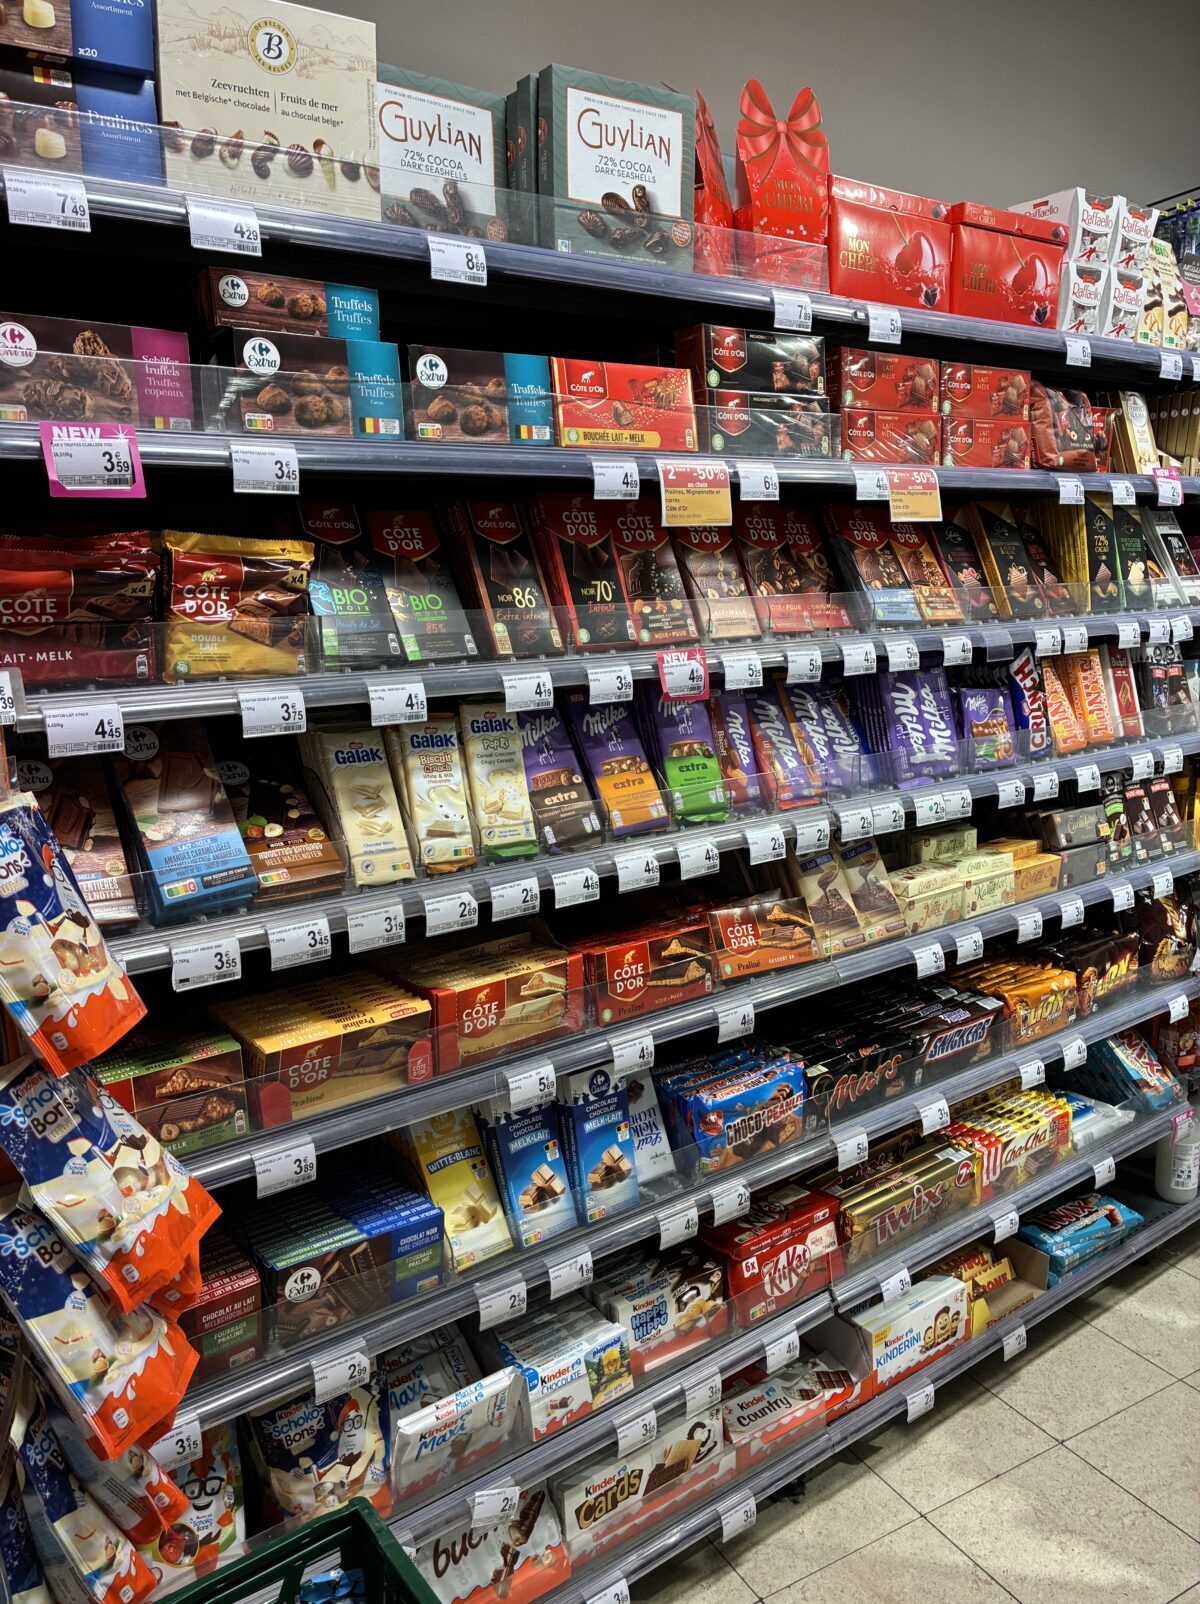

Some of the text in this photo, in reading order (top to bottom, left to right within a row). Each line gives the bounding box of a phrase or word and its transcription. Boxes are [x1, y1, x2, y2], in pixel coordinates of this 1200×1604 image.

[90, 1, 133, 16] Assortiment
[78, 46, 98, 58] x20
[262, 33, 284, 60] B
[210, 78, 270, 99] Zeevruchten
[175, 89, 192, 99] met
[233, 100, 271, 113] chocolade
[280, 91, 339, 112] Fruits de mer
[281, 109, 290, 117] au
[291, 110, 320, 123] chocolat
[100, 130, 142, 144] Assortiment
[403, 149, 464, 171] 72% COCOA
[598, 155, 653, 174] 72% COCOA
[424, 166, 468, 181] SEASHELLS
[614, 170, 656, 184] SEASHELLS
[775, 179, 800, 191] MON
[1081, 208, 1113, 230] Raffaello
[1121, 215, 1152, 239] Raffaello
[848, 237, 870, 253] MON
[222, 287, 248, 301] Extra
[1072, 282, 1101, 301] Raffaello
[1113, 287, 1143, 308] Raffaello
[332, 297, 373, 312] Truffels
[334, 310, 372, 325] Truffes
[247, 354, 279, 369] Extra
[146, 377, 180, 388] Truffes
[355, 372, 396, 387] Truffels
[419, 370, 446, 383] Extra
[144, 387, 184, 399] copeaux
[358, 385, 395, 399] Truffes
[512, 383, 546, 395] Truffels
[570, 381, 589, 393] CÔTE
[977, 383, 990, 391] MELK
[52, 426, 101, 440] NEW
[583, 430, 645, 443] BOUCHÉE LAIT MELK
[693, 466, 725, 480] -50%
[308, 518, 355, 531] CÔTE D'OR
[562, 510, 596, 524] CÔTE
[383, 525, 422, 539] CÔTE
[567, 523, 598, 537] D'OR
[388, 540, 424, 551] D'OR
[291, 574, 304, 584] x4
[182, 583, 230, 600] CÔTE
[332, 588, 368, 606] BIO
[581, 588, 595, 596] NOIR
[185, 600, 228, 615] D'OR
[409, 594, 443, 611] BIO
[496, 611, 518, 622] Extra
[425, 623, 446, 634] 85%
[190, 633, 228, 644] DOUBLE
[199, 643, 219, 651] LAIT
[36, 651, 73, 662] MELK
[663, 652, 689, 664] NEW
[1013, 656, 1046, 749] CRUNCH
[470, 718, 513, 735] Galak
[582, 705, 628, 736] Milka
[890, 682, 927, 761] Milka
[521, 715, 560, 749] Milka
[728, 710, 752, 767] Milka
[410, 734, 456, 749] Galak
[717, 730, 728, 757] Biscoff
[335, 748, 383, 765] Galak
[420, 752, 453, 766] Biscuit
[423, 763, 452, 774] Crunch
[678, 762, 709, 773] extra
[613, 776, 645, 790] extra
[544, 790, 578, 805] extra
[265, 857, 283, 866] HELE
[284, 850, 323, 864] HAZELNOTEN
[727, 923, 755, 938] CÔTE
[614, 962, 645, 980] CÔTE
[737, 960, 761, 971] Praliné
[616, 976, 644, 994] D'OR
[463, 1001, 499, 1021] CÔTE
[618, 1003, 645, 1016] Praliné
[464, 1016, 497, 1034] D'OR
[928, 1017, 991, 1061] SNICKERS
[288, 1055, 331, 1079] CÔTE
[289, 1070, 328, 1089] D'OR
[825, 1054, 903, 1117] Mars
[586, 1096, 619, 1113] CHOCOLADE
[589, 1104, 617, 1119] CHOCOLAT
[744, 1260, 756, 1273] 6x
[541, 1370, 582, 1394] CHOCOLATE
[736, 1395, 792, 1428] Country
[284, 1426, 317, 1449] Bons
